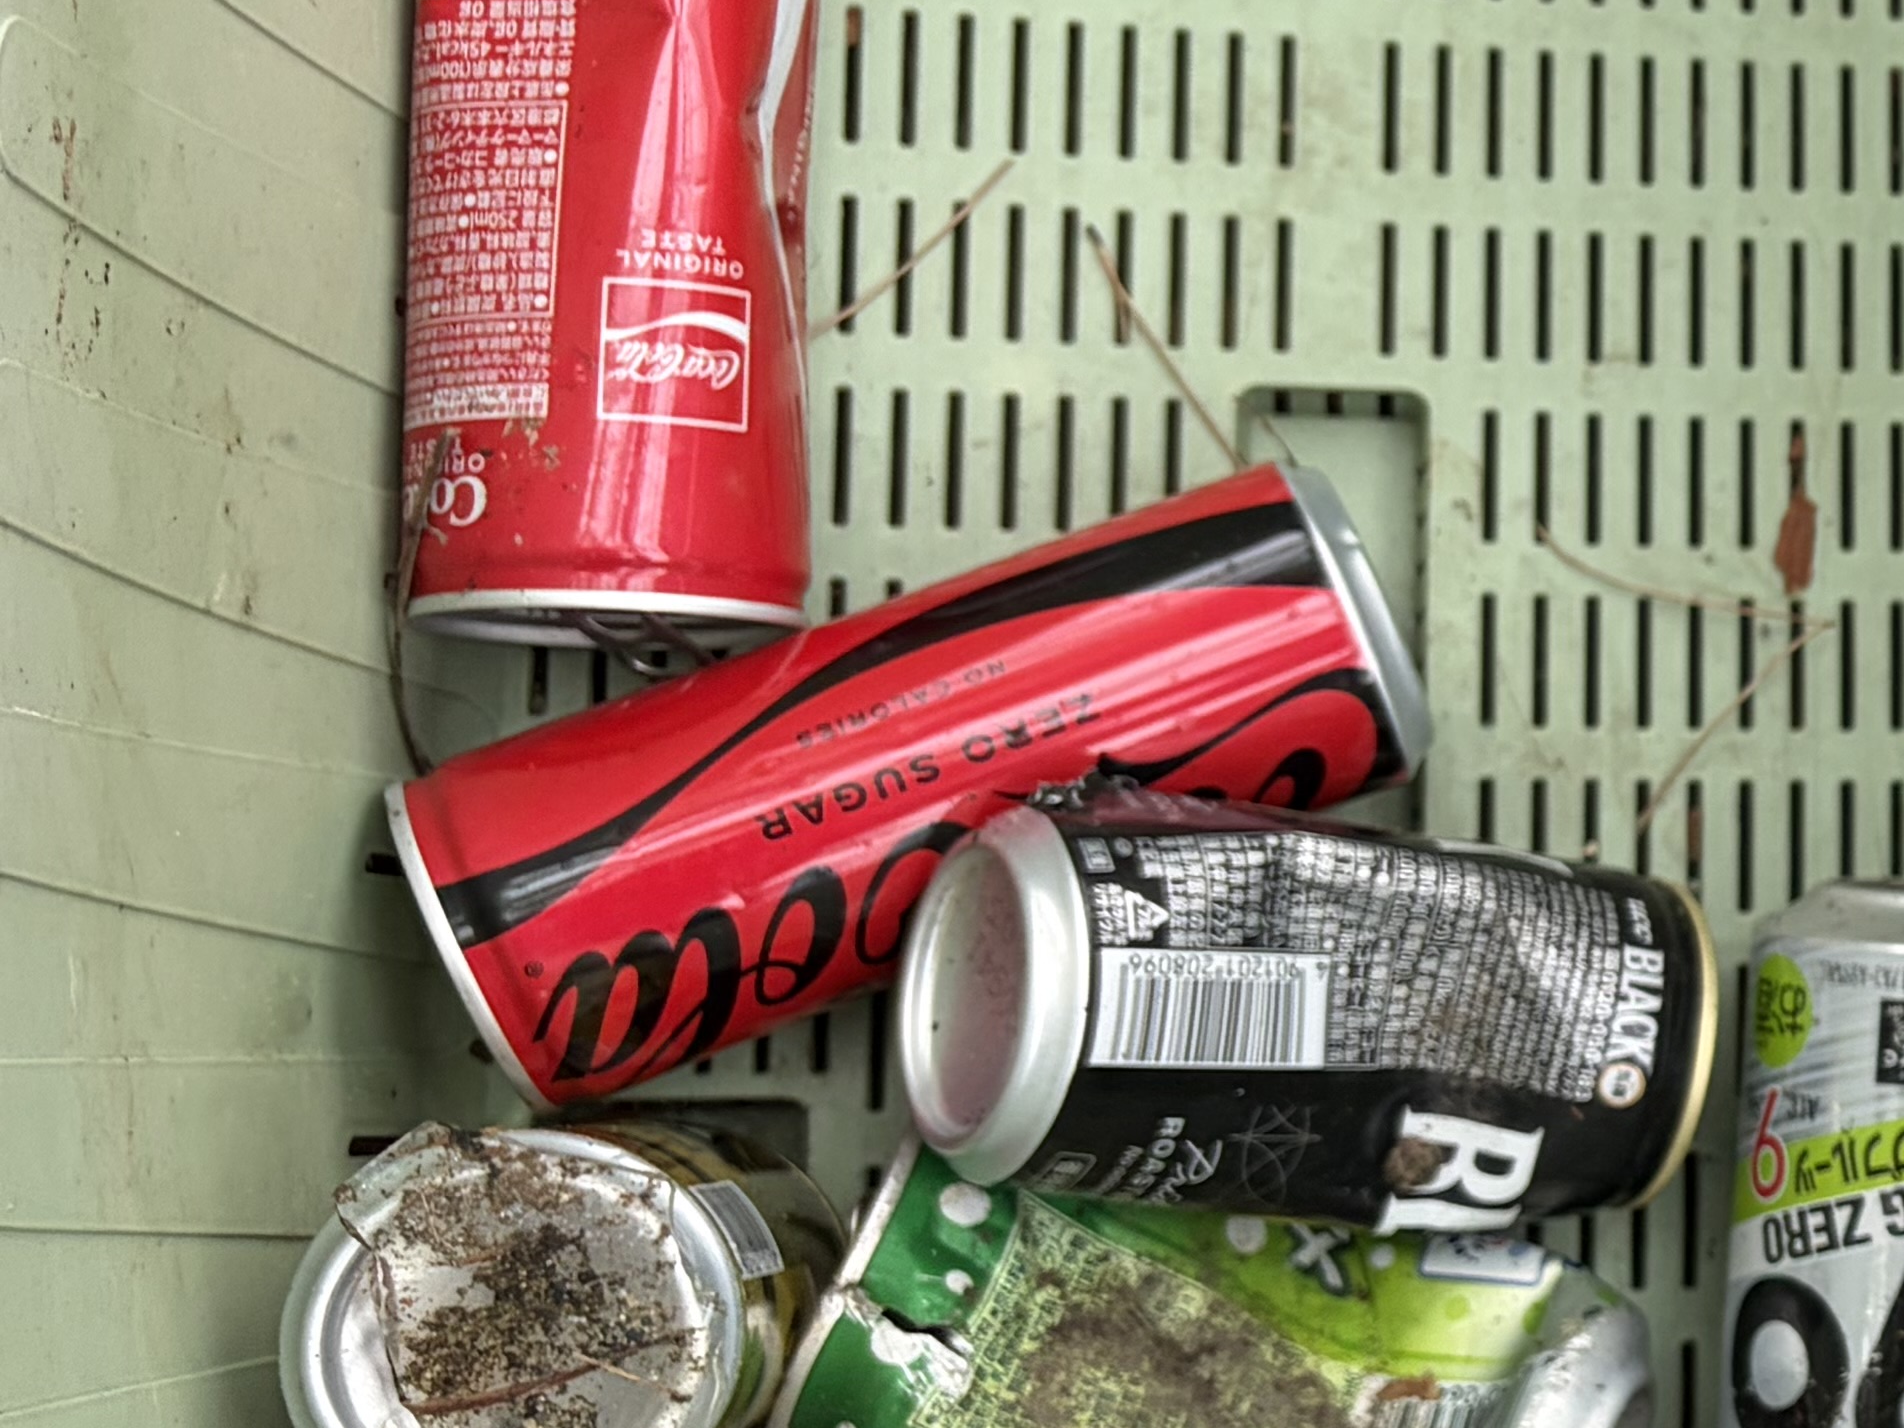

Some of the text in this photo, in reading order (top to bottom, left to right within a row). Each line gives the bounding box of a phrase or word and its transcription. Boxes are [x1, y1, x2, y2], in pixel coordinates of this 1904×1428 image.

[615, 248, 744, 280] ORIGINAL
[639, 228, 726, 252] TASTE
[797, 658, 1008, 747] NO CALORIES
[759, 690, 1104, 842] ZERO SUGAR
[1607, 943, 1665, 1074] BLACK
[1756, 977, 1808, 1040] お酒
[1761, 1196, 1872, 1266] ZERO
